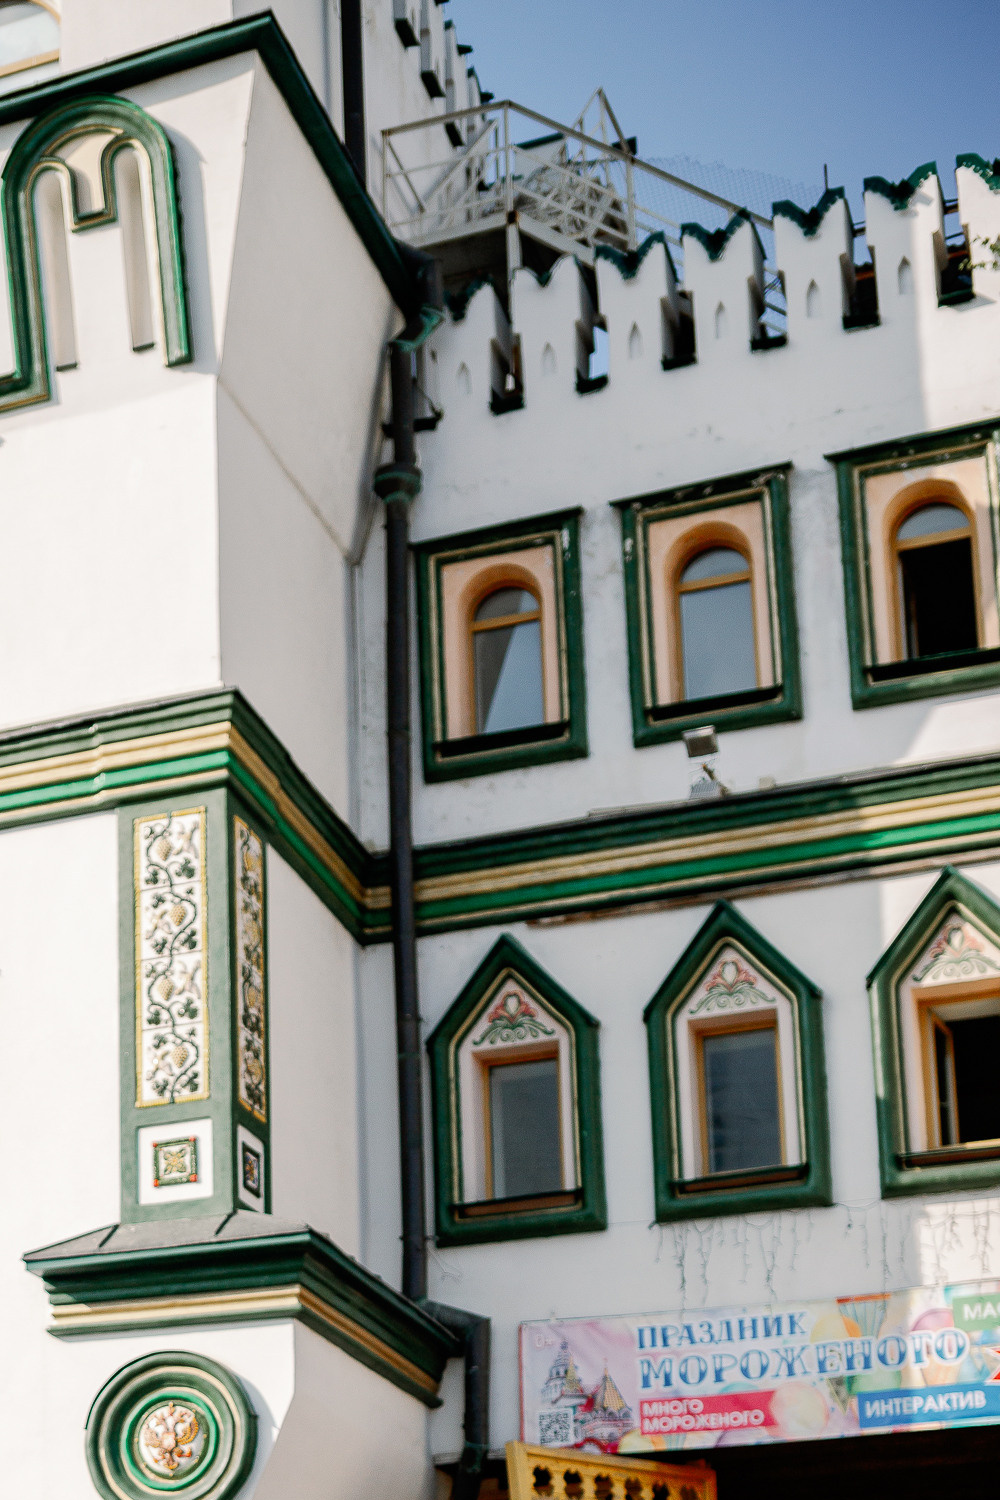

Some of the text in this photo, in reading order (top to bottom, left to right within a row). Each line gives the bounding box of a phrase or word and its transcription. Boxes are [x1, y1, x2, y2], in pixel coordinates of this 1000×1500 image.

[963, 1300, 1000, 1321] МА
[635, 1310, 808, 1350] ПРАЗДНИК
[637, 1329, 970, 1390] МОРОЖЕНОГО
[642, 1398, 705, 1418] МНОГО
[865, 1390, 987, 1420] ИНТЕРАКТИВ
[642, 1408, 766, 1434] МОРОЖЕНОГО
